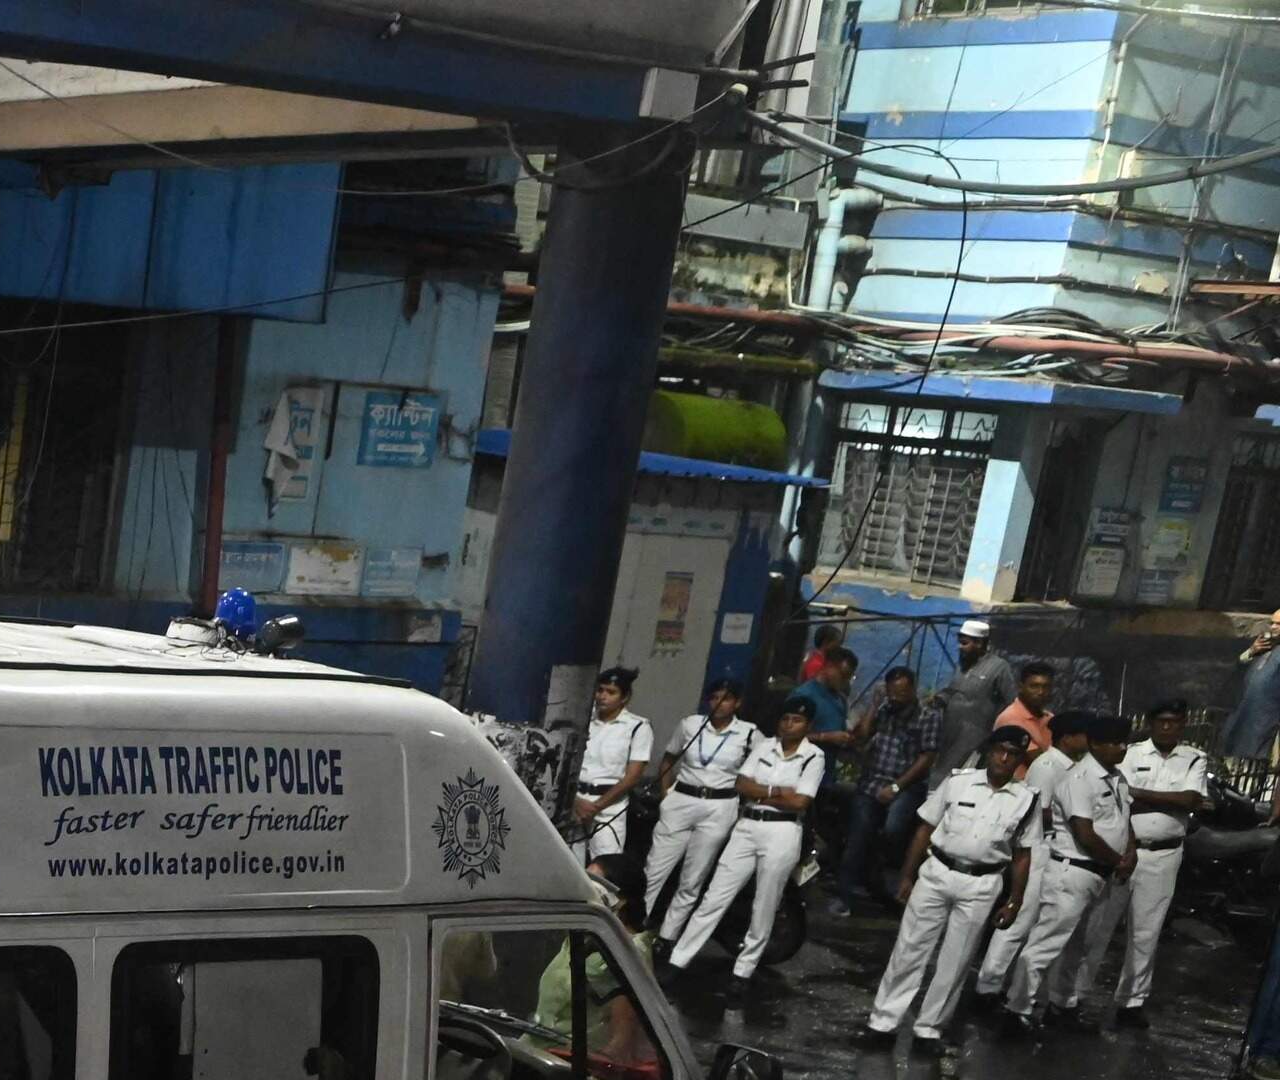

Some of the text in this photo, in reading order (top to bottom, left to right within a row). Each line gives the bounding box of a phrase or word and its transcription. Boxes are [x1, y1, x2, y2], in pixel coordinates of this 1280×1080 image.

[40, 746, 344, 798] KOLKATA TRAFFIC POLICE
[44, 803, 349, 846] faster safer friendlier
[48, 850, 345, 882] www.kolkatapolice.gov.in
